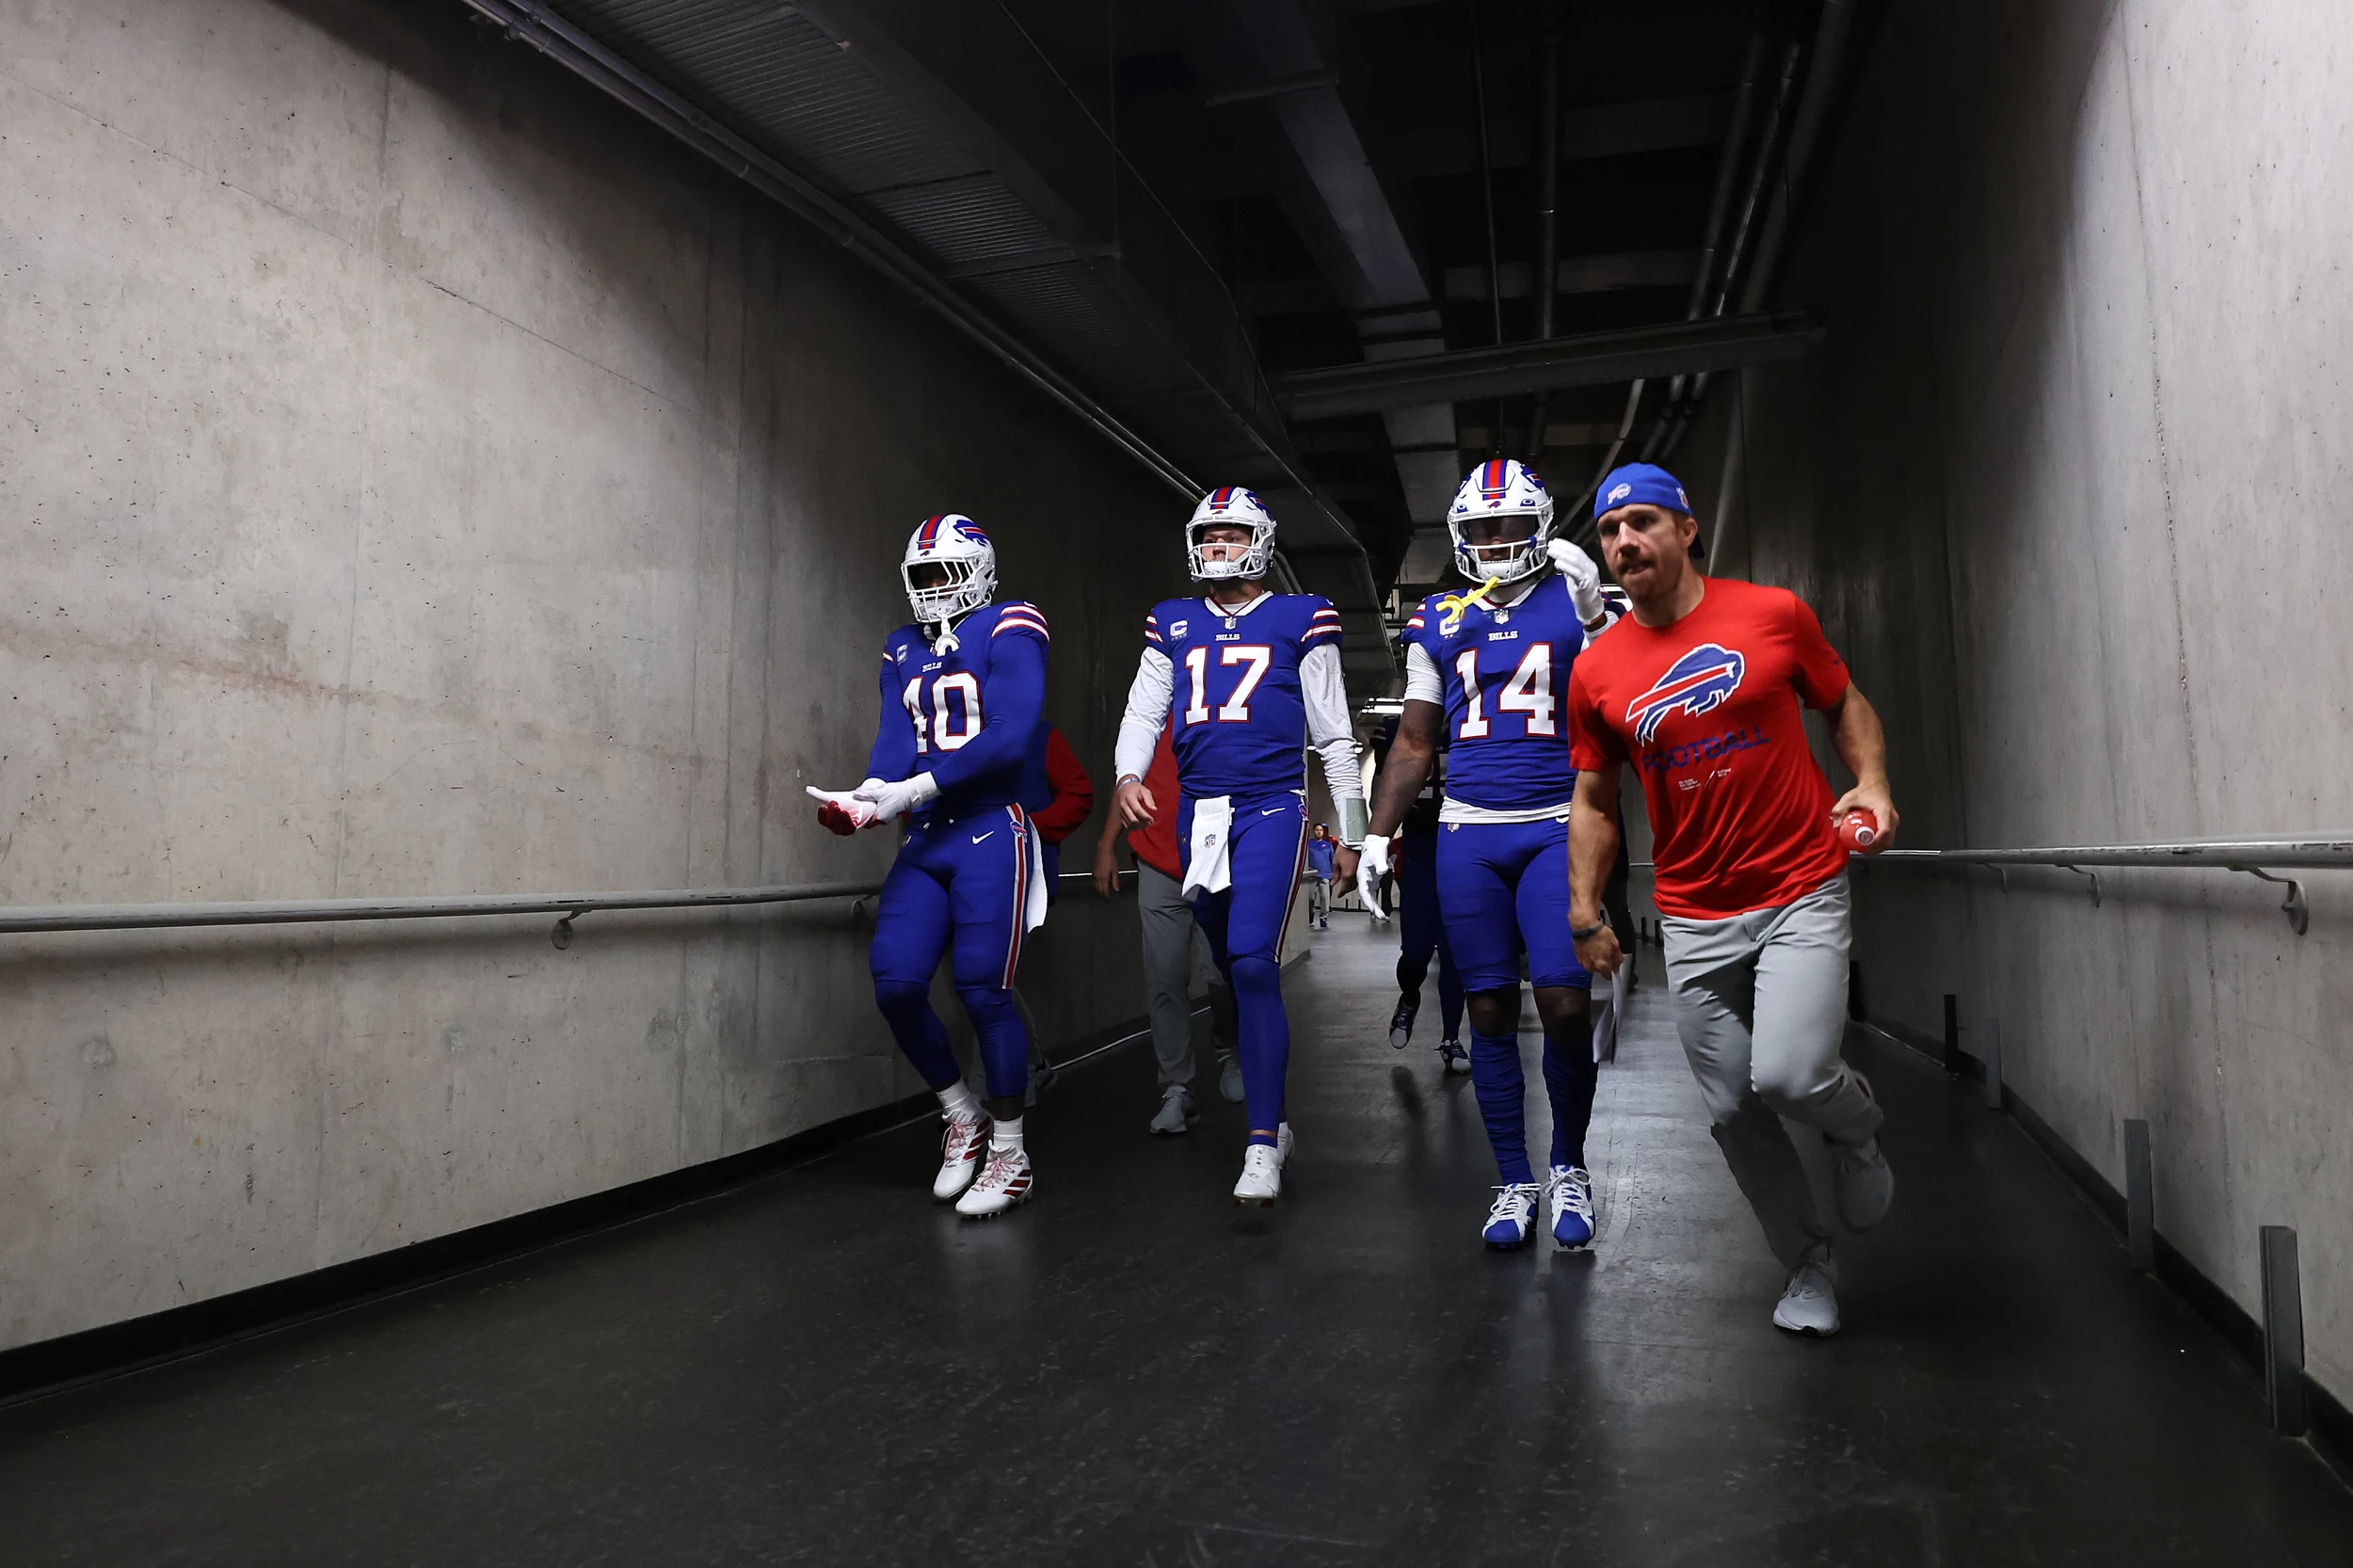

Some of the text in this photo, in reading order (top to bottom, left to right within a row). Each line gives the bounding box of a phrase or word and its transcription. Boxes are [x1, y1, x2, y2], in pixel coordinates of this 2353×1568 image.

[1170, 620, 1188, 636] C
[1488, 631, 1518, 641] BILLS
[1185, 645, 1272, 726] 17
[1455, 642, 1557, 739] 14
[1642, 725, 1771, 774] FOOTBALL
